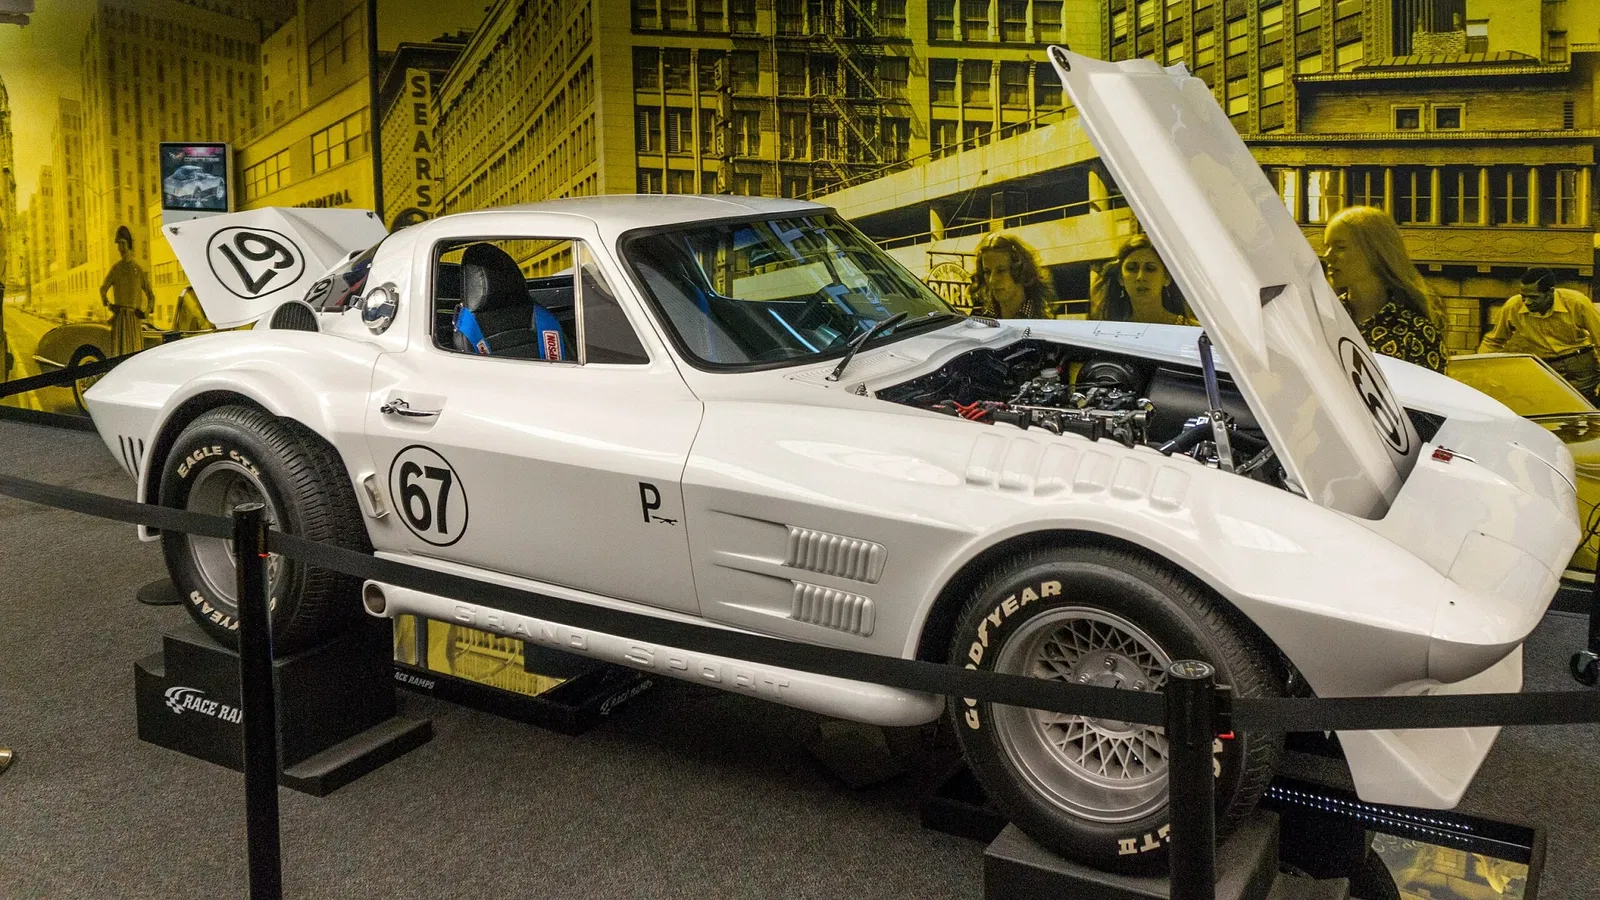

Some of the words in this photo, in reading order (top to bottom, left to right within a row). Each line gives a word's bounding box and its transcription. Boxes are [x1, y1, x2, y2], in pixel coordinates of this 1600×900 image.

[410, 75, 433, 208] SEARS
[217, 231, 295, 296] 67
[928, 281, 974, 307] PARK
[1351, 344, 1402, 447] 67
[176, 445, 223, 479] EAGLE
[399, 461, 453, 535] 67
[638, 481, 662, 523] P
[454, 605, 589, 651] GRAND
[624, 644, 790, 700] SPORT
[393, 671, 409, 682] ACE
[407, 675, 435, 690] RAMPS
[182, 693, 220, 717] RACE
[217, 704, 243, 725] RA
